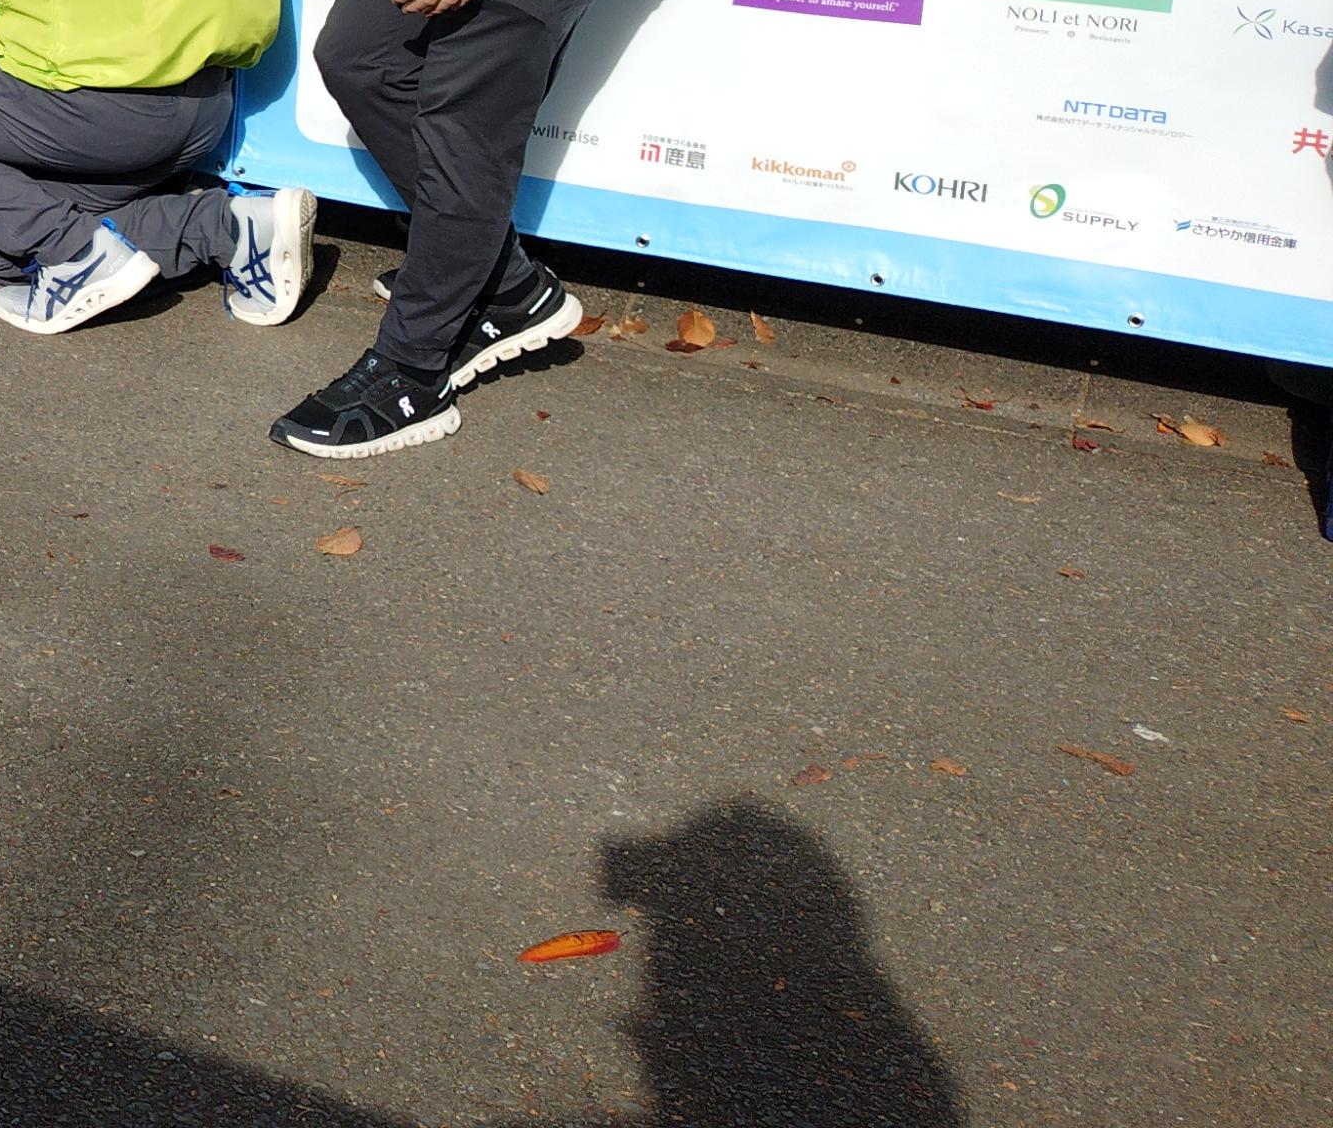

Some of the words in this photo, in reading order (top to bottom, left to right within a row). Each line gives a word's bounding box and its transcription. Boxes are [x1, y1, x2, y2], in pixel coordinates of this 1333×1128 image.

[1007, 5, 1057, 24] NOLI
[1063, 12, 1079, 26] et
[1087, 14, 1138, 33] NORI
[1283, 19, 1333, 38] Kasa
[532, 125, 559, 139] will
[562, 130, 600, 146] raise
[643, 134, 707, 150] 100年をつくる会社
[664, 147, 706, 170] 鹿島
[751, 157, 845, 182] kikkoman
[894, 171, 988, 203] KOHRI
[1062, 211, 1139, 232] SUPPLY
[1192, 224, 1297, 250] さわやか信用金庫
